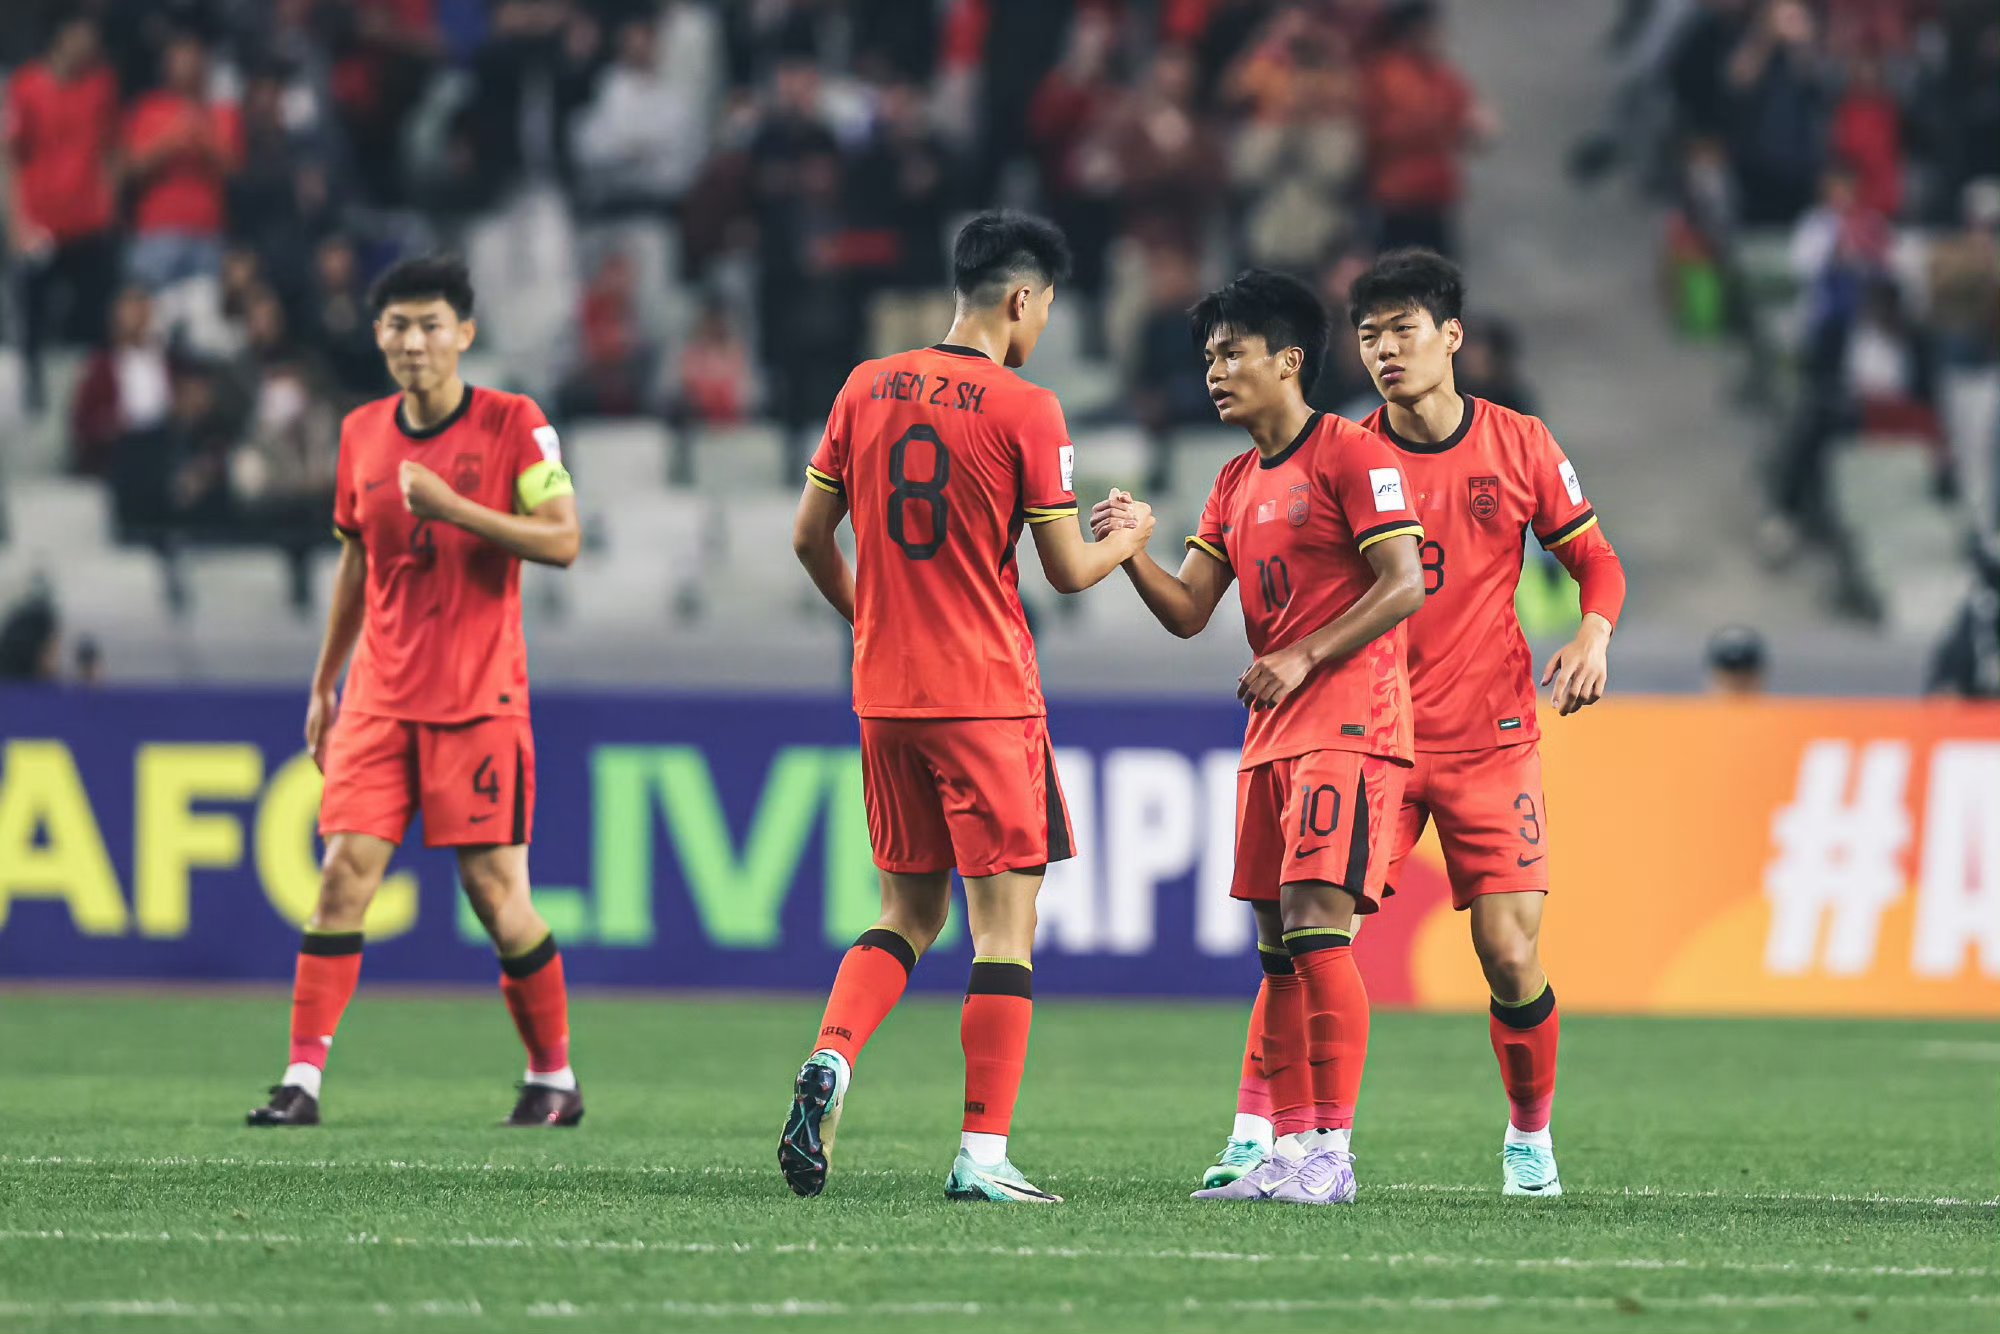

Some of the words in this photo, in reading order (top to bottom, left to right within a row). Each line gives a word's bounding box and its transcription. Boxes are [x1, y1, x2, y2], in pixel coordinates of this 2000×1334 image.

[871, 371, 927, 401] CHEN
[929, 375, 949, 407] Z.
[953, 381, 986, 415] SH.
[887, 423, 950, 560] 8
[1378, 483, 1398, 494] AFC
[1256, 555, 1292, 613] 10
[1418, 541, 1445, 596] 3
[473, 754, 500, 804] 4
[1300, 784, 1342, 837] 10
[1513, 793, 1541, 846] 3
[0, 739, 420, 942] AFC
[1763, 738, 2000, 979] #A
